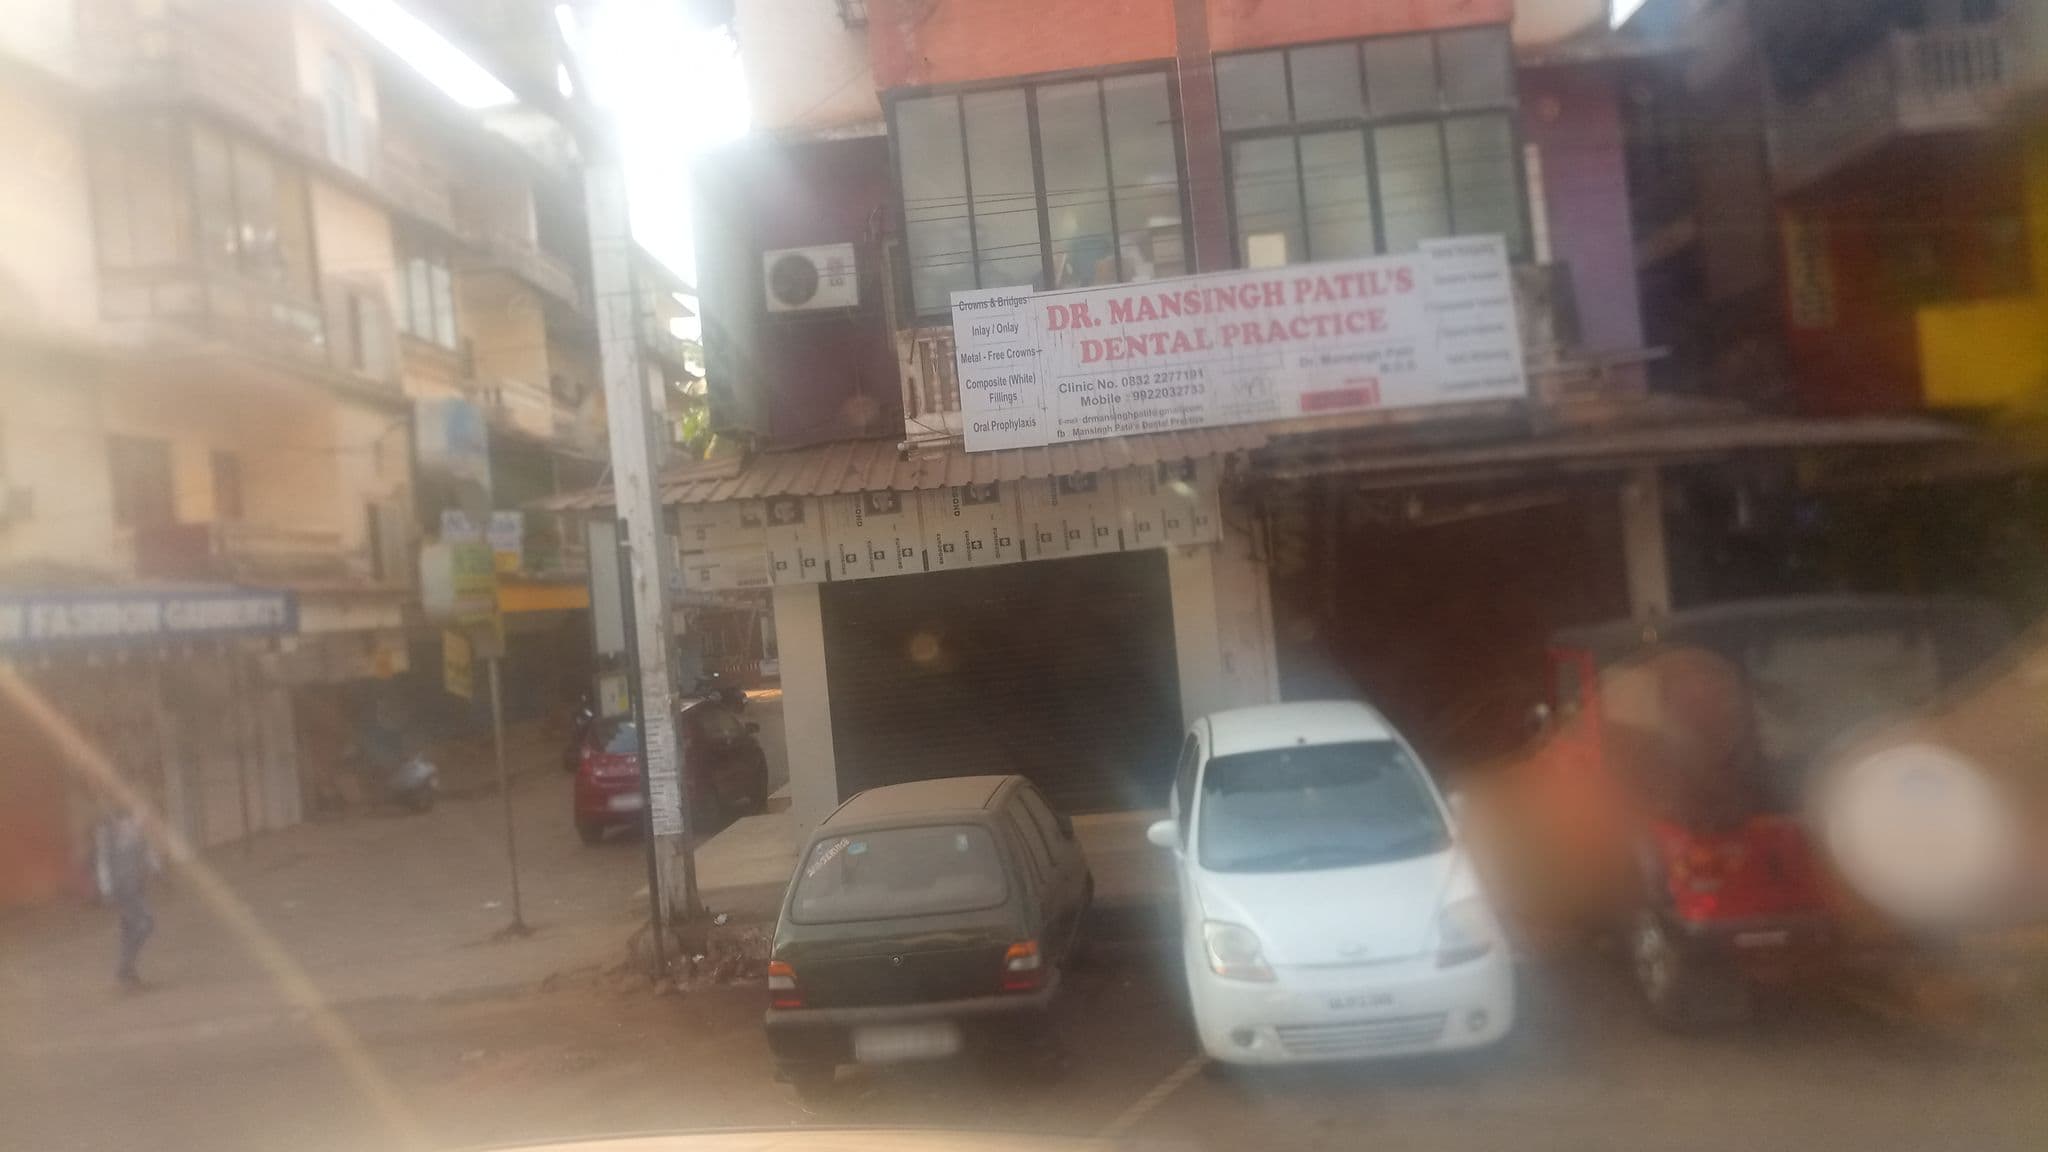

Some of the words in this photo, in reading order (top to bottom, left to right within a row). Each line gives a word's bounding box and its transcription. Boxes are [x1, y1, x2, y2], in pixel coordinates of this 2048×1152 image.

[959, 300, 989, 312] Crowns
[989, 297, 997, 308] &
[997, 295, 1028, 308] Bridges
[1046, 301, 1102, 332] DR.
[1108, 278, 1284, 325] MANSINGH
[1293, 266, 1415, 304] PATIL'S
[972, 325, 991, 337] Inlay
[996, 322, 1019, 334] Onlay
[1080, 326, 1214, 365] DENTAL
[1221, 308, 1388, 348] PRACTICE
[960, 352, 982, 364] Metal
[988, 350, 1005, 361] Free
[1006, 347, 1036, 359] Crowns
[965, 376, 1007, 390] Composite
[1008, 371, 1036, 387] (White)
[1058, 380, 1094, 394] Clinic
[1097, 378, 1119, 390] No.
[1121, 374, 1150, 387] 0832
[989, 390, 1018, 406] Fillings
[1080, 392, 1122, 408] Mobile
[973, 421, 990, 433] Oral
[991, 416, 1037, 431] Prophylaxis
